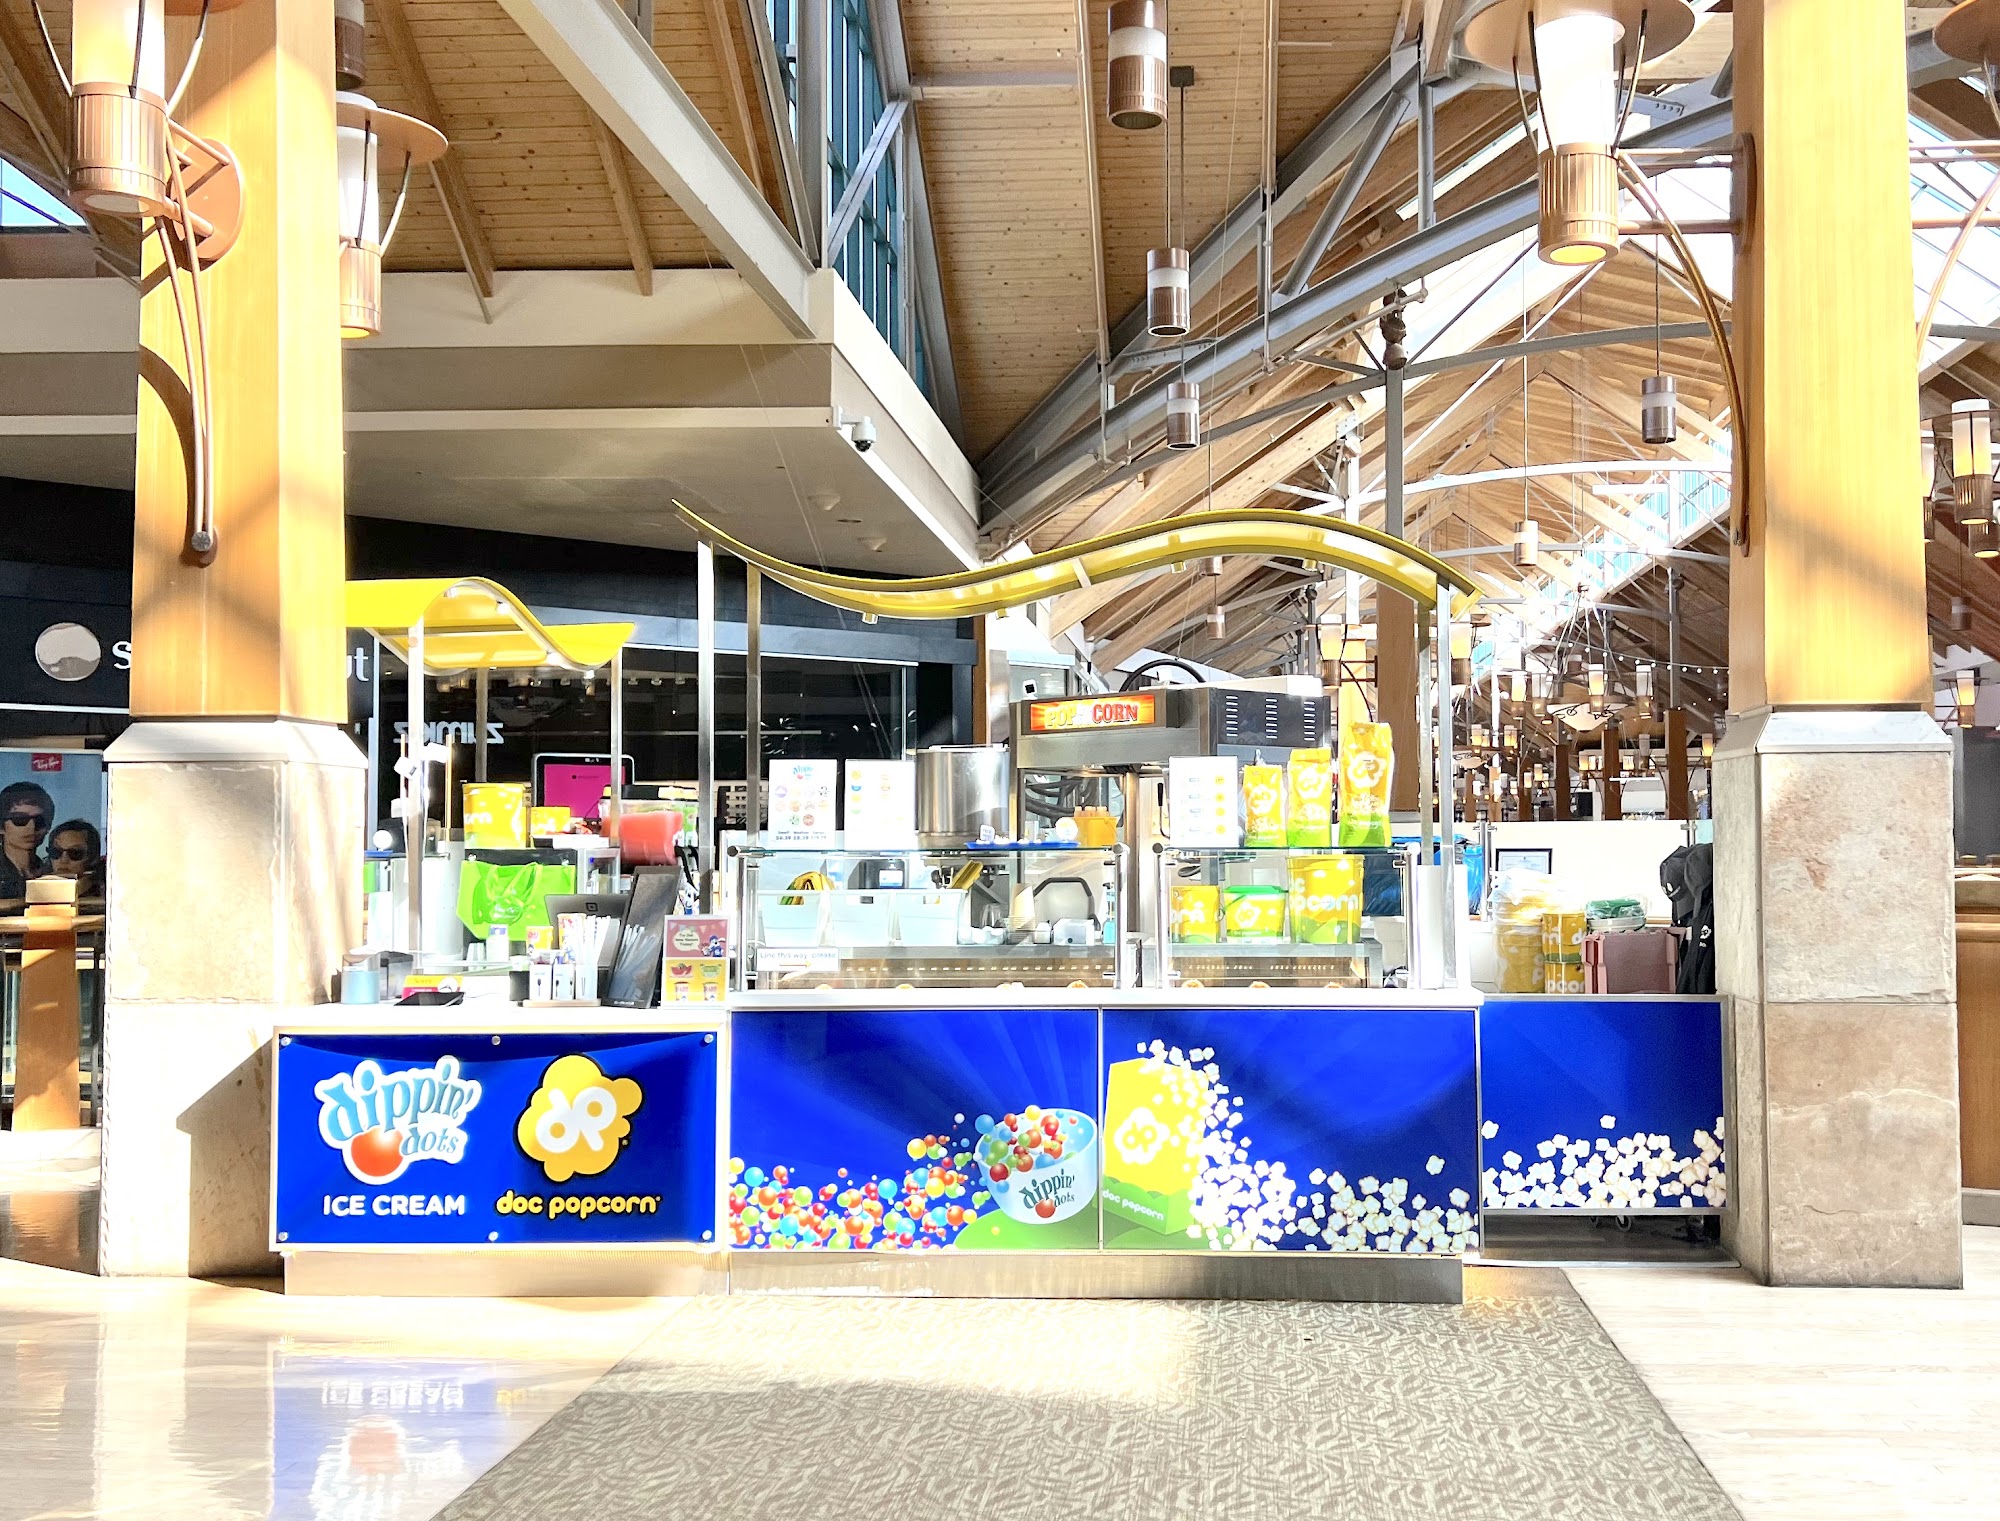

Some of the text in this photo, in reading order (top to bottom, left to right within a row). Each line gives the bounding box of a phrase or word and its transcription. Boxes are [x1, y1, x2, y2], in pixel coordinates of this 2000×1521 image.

[1046, 703, 1138, 727] POP CORN
[323, 1063, 474, 1142] dippin'
[401, 1127, 459, 1156] dots
[1019, 1168, 1075, 1209] dippin'
[1053, 1192, 1075, 1208] dots
[323, 1194, 465, 1217] ICE CREAM
[497, 1190, 657, 1220] doc popcorn
[1103, 1189, 1164, 1221] doc popcorn
